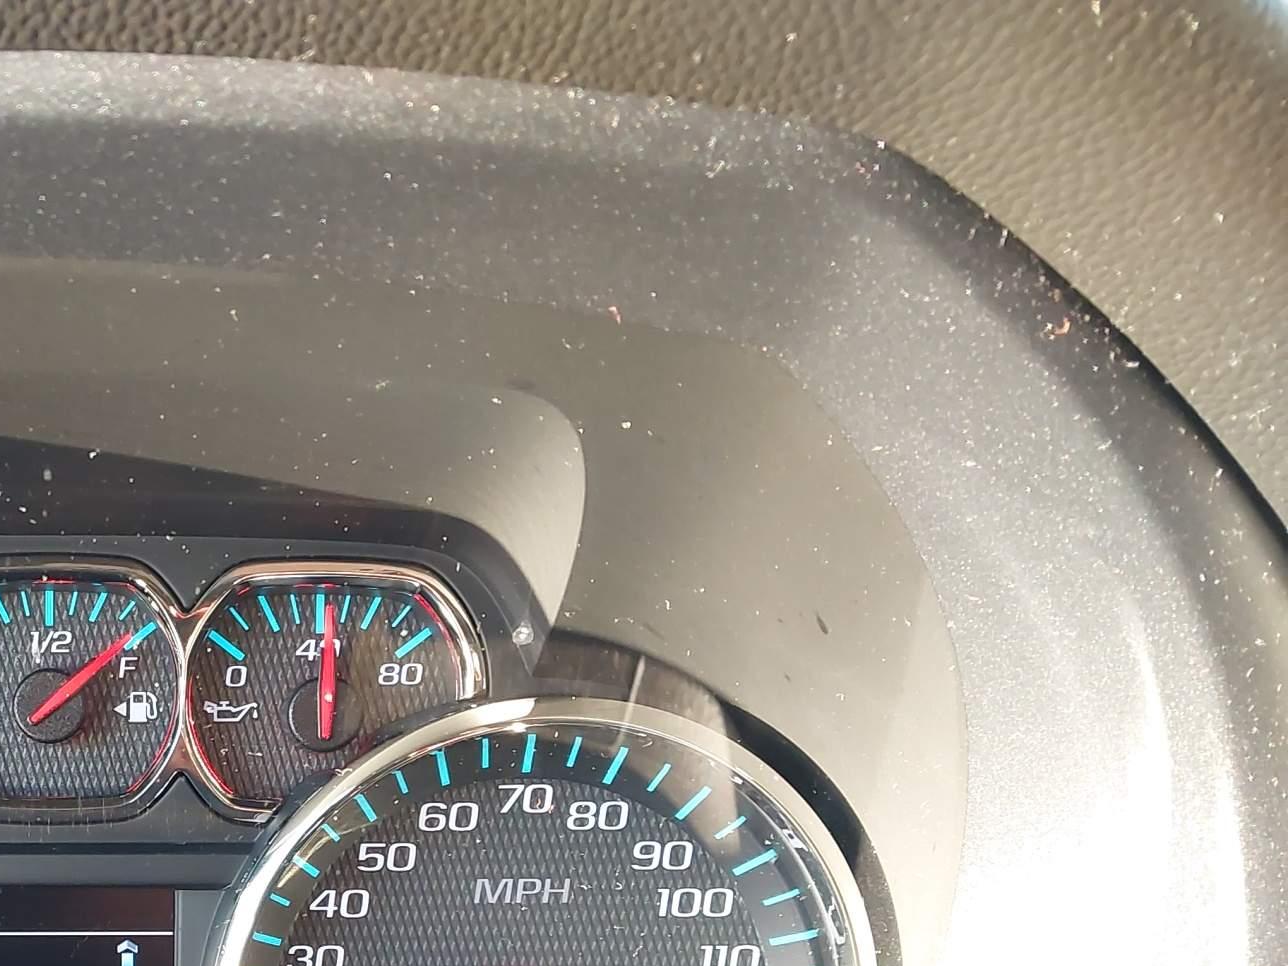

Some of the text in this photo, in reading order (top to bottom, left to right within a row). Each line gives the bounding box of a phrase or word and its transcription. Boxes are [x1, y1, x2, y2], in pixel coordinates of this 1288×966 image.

[30, 630, 73, 654] 1/2
[118, 656, 138, 679] F
[225, 666, 248, 688] 0
[379, 664, 423, 686] 80
[497, 784, 554, 814] 70
[417, 802, 478, 831] 60
[566, 800, 629, 831] 80
[357, 843, 416, 872] 50
[631, 840, 693, 870] 90
[310, 889, 369, 918] 40
[473, 878, 572, 905] MPH
[657, 888, 734, 917] 100
